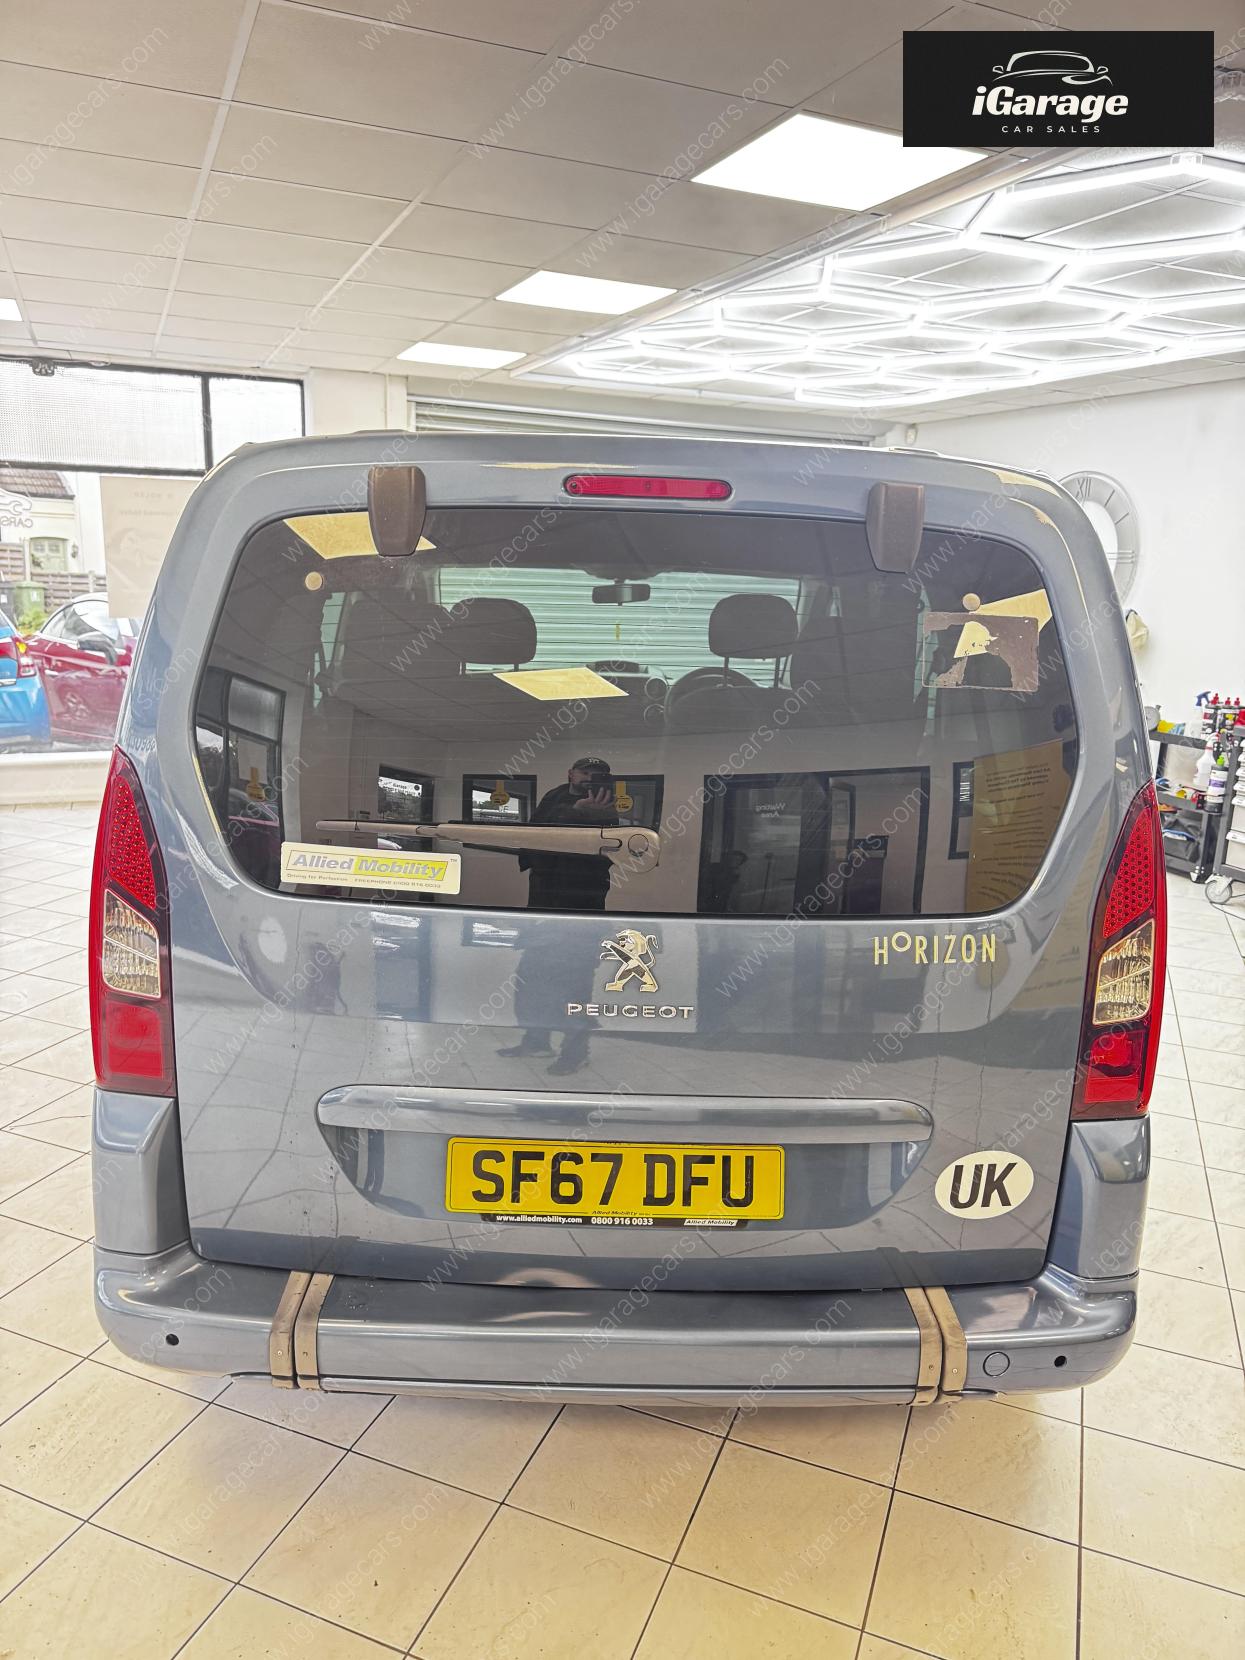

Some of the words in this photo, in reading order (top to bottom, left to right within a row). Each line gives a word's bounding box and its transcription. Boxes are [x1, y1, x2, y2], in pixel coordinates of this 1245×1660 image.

[293, 854, 355, 870] Allied
[358, 859, 444, 878] Mobility
[874, 931, 996, 965] HORIZON
[567, 1003, 694, 1019] PEUGEOT
[471, 1149, 624, 1206] SF67
[642, 1153, 754, 1208] DFU
[949, 1162, 1018, 1210] UK
[496, 1215, 583, 1224] www.alliedmobility.com
[591, 1217, 613, 1225] 0800
[632, 1218, 653, 1226] 0033
